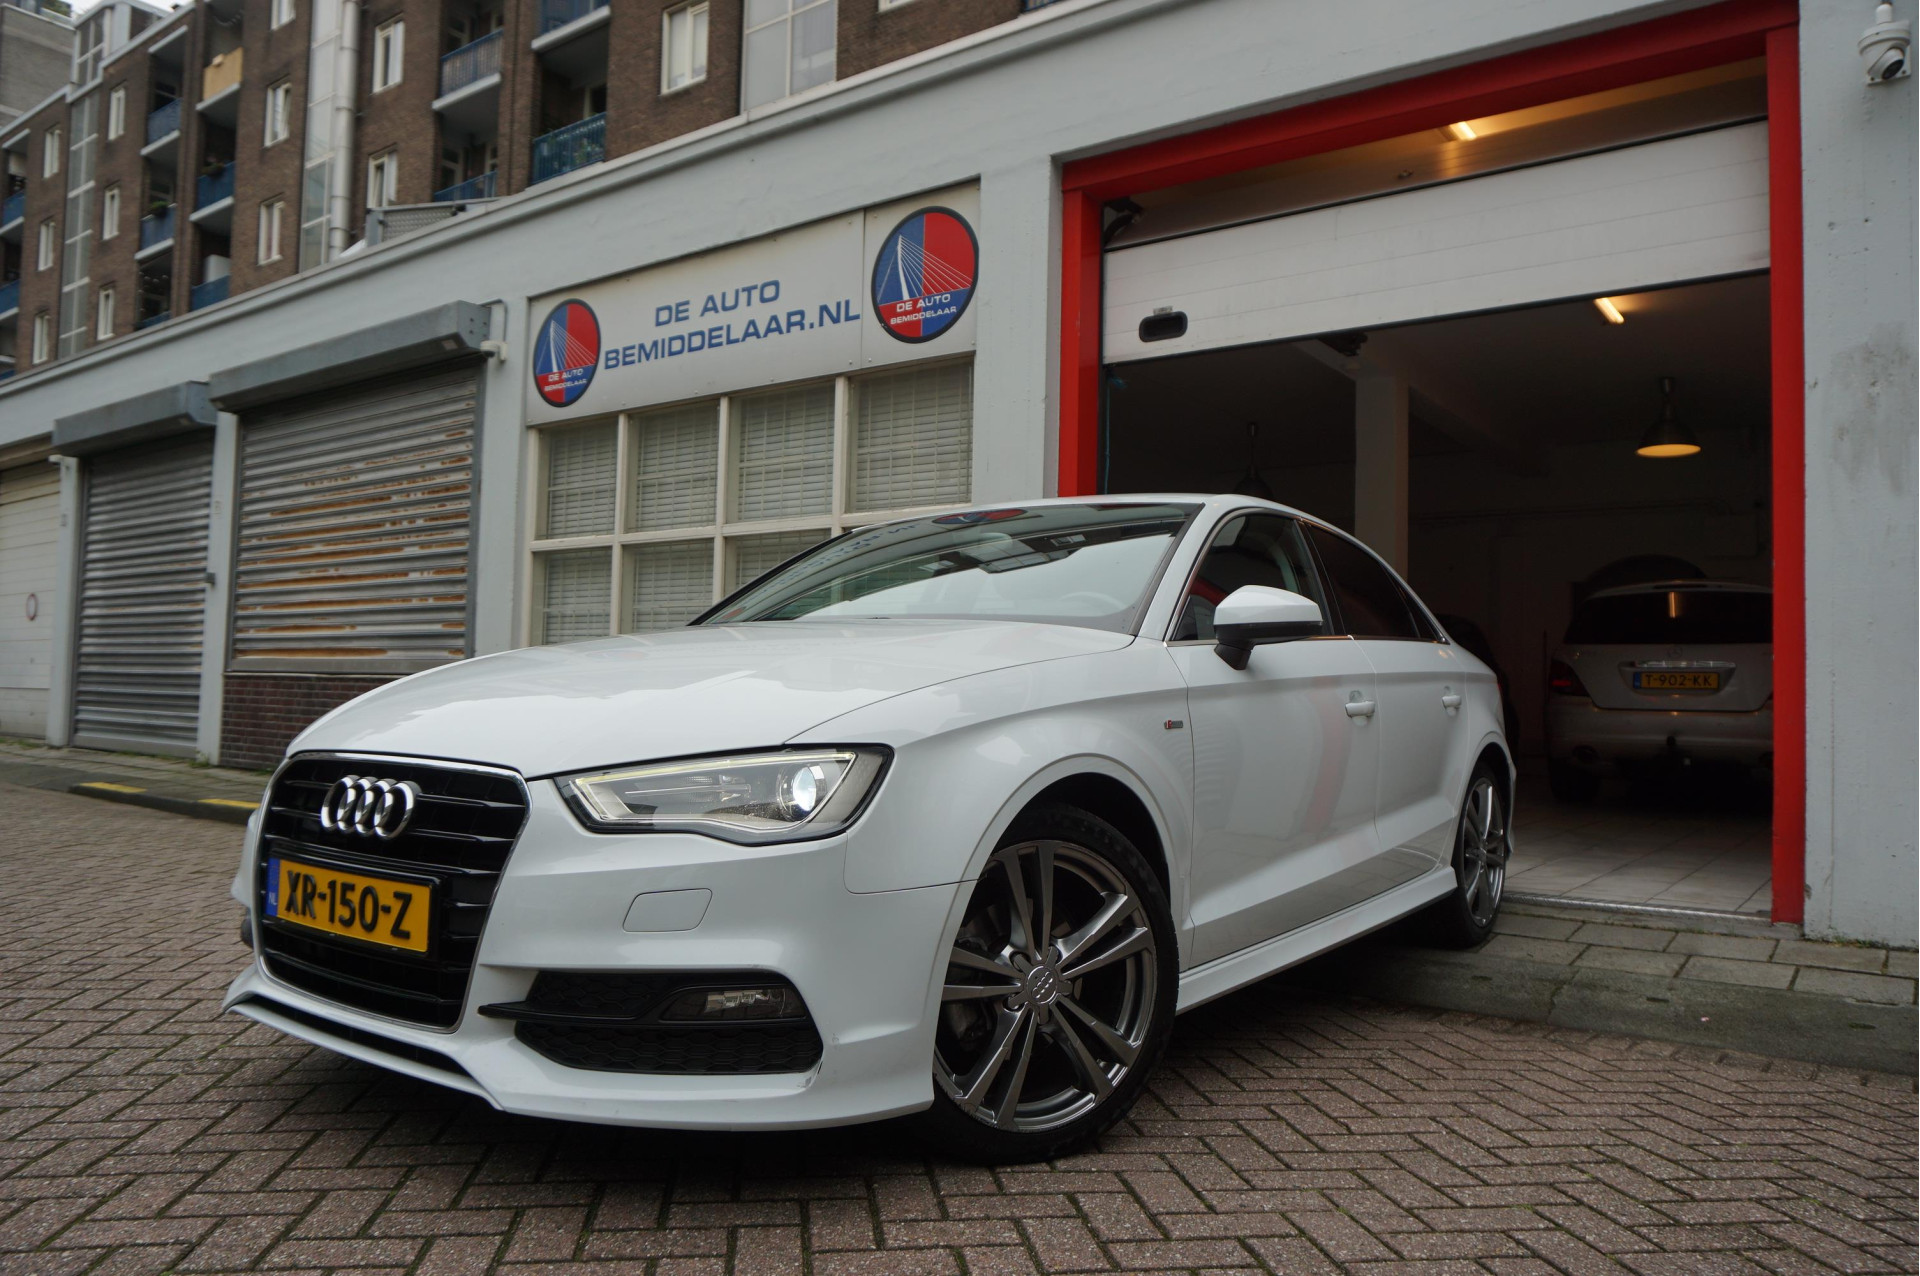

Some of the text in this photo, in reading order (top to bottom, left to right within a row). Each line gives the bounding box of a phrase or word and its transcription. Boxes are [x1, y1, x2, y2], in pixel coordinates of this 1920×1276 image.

[655, 279, 780, 327] DE AUTO
[896, 293, 951, 312] DE AUTO
[890, 306, 957, 325] BEMIDDELAAR
[604, 299, 861, 370] BEMIDDELAAR.NL
[548, 368, 584, 382] DE AUTO
[1645, 674, 1713, 687] T-902-KK
[285, 870, 413, 940] XR-150-Z
